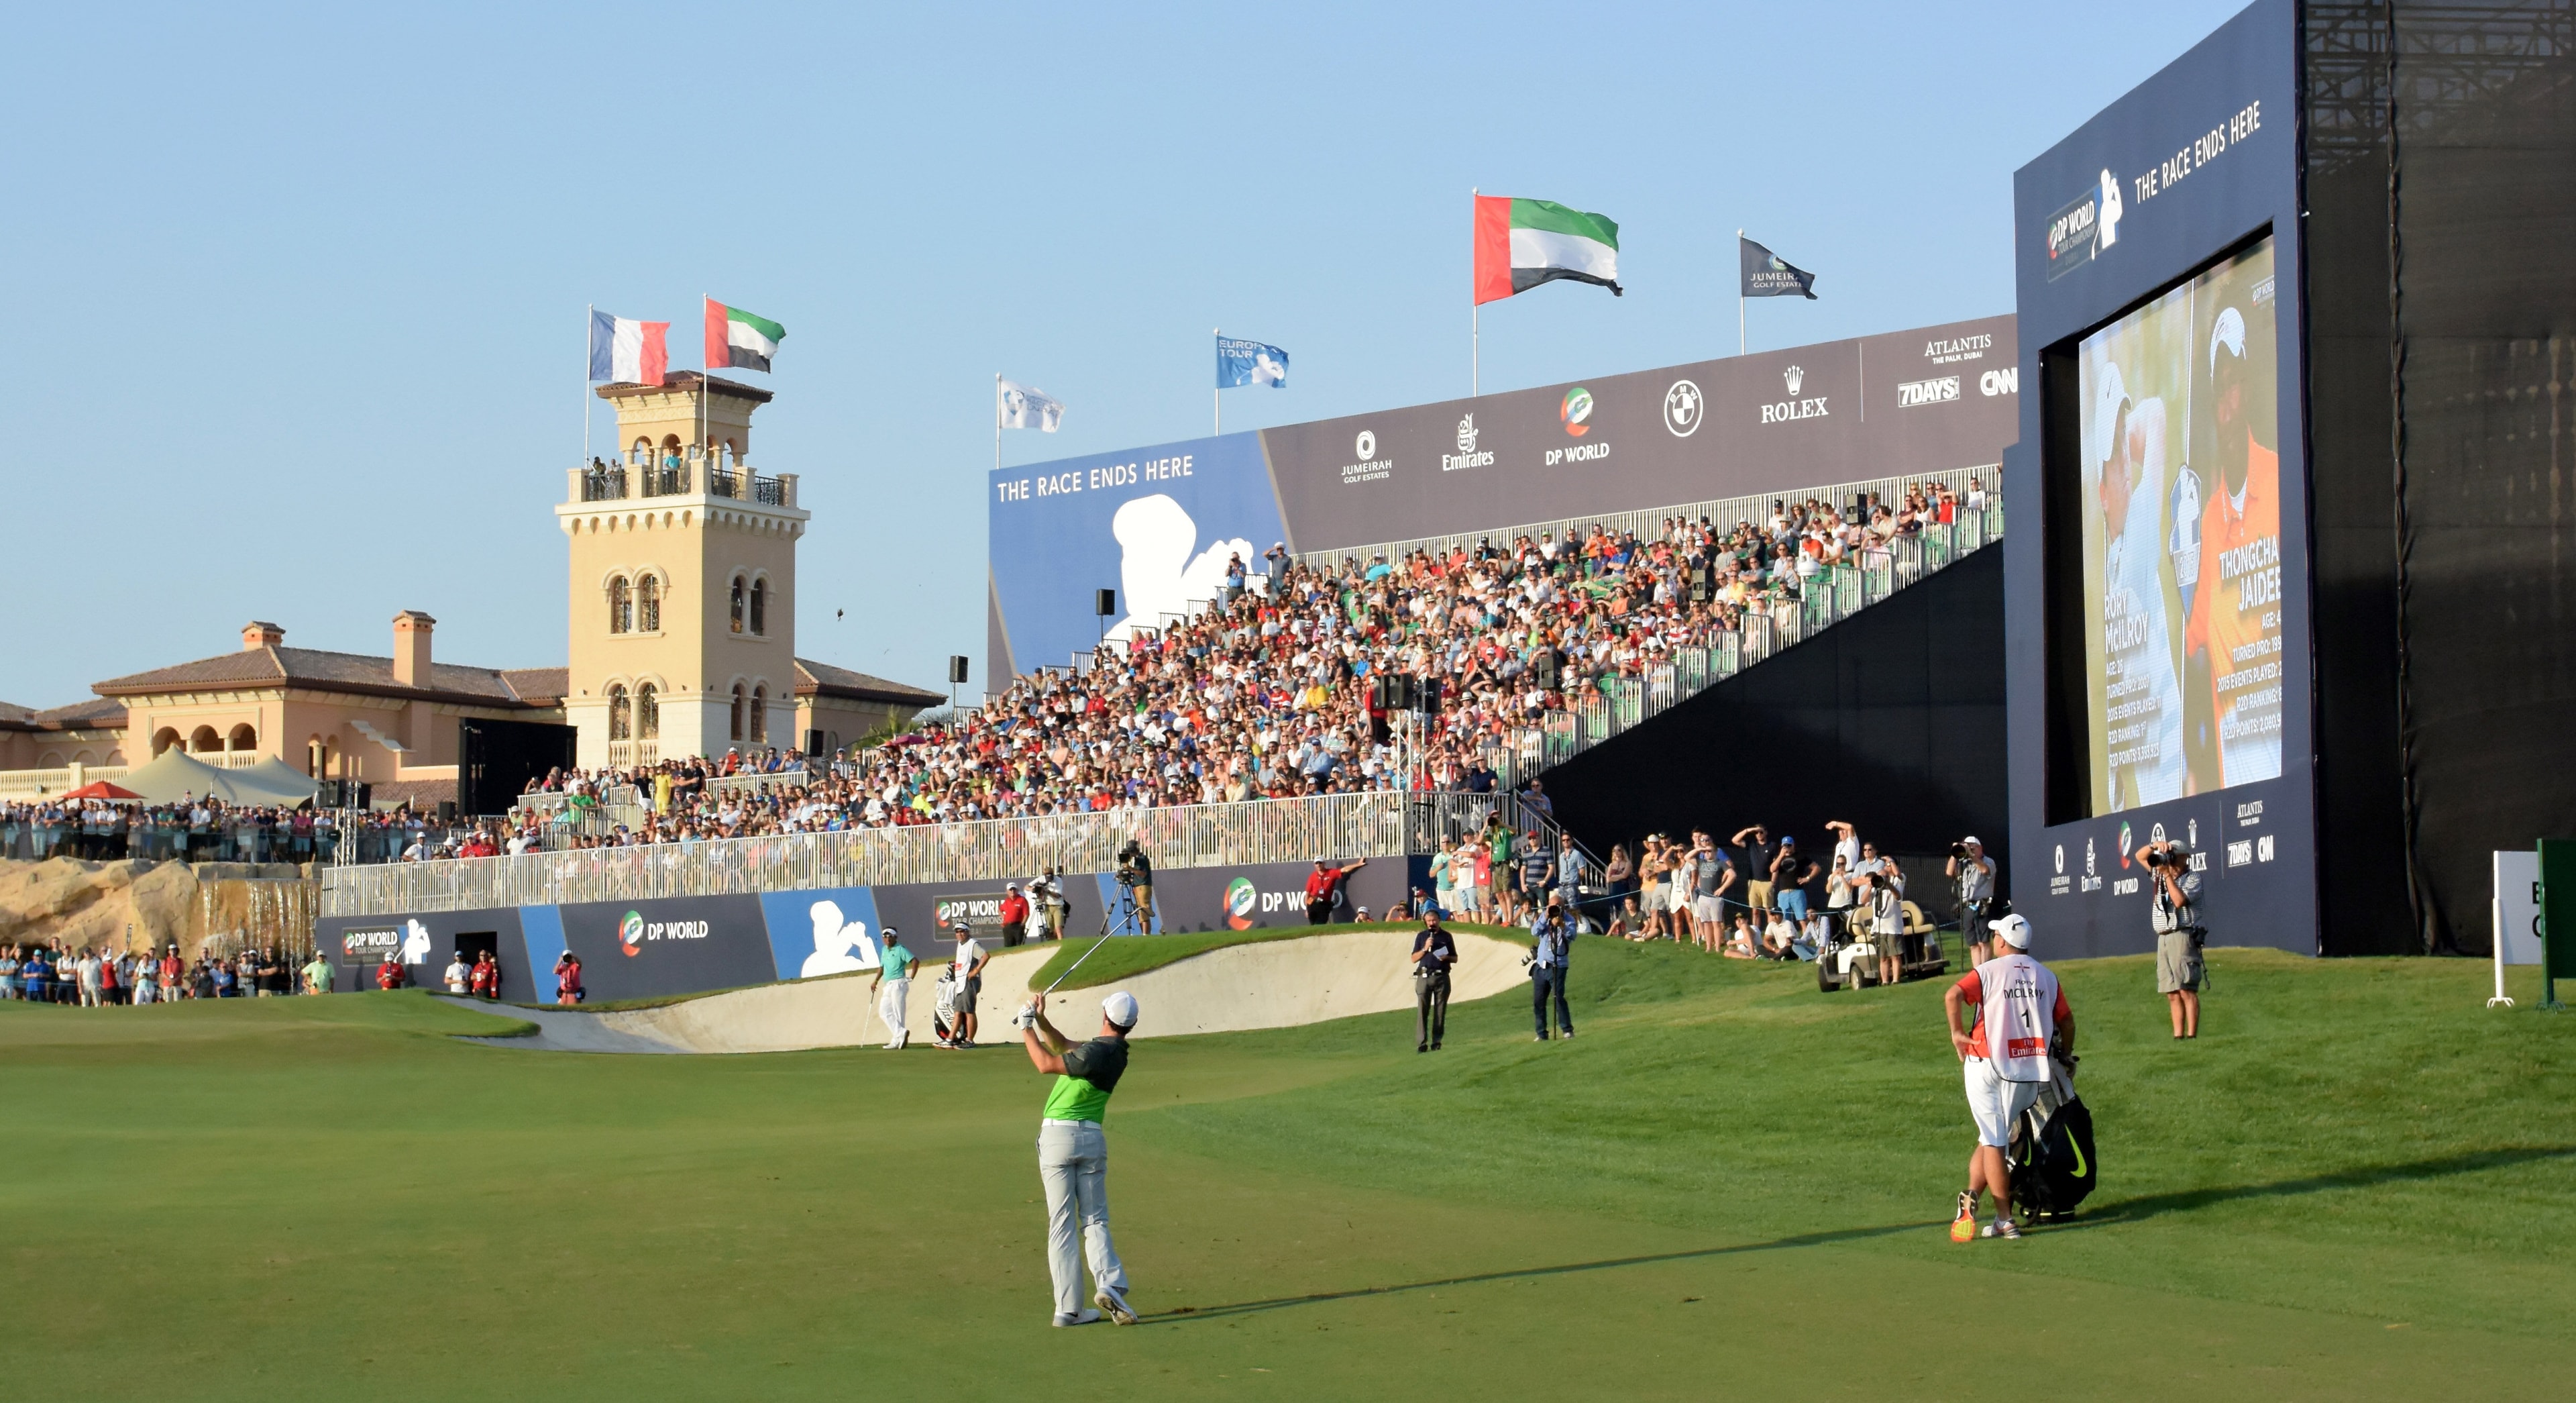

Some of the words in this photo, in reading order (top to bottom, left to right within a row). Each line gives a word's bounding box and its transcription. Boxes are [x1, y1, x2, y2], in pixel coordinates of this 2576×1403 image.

[2135, 168, 2157, 204] THE
[2162, 147, 2191, 189] RACE
[2195, 123, 2225, 168] ENDS
[2231, 100, 2261, 145] HERE
[2057, 217, 2068, 242] DP
[2068, 200, 2094, 235] WORLD
[1220, 348, 1253, 358] TOUR
[1924, 333, 1992, 357] ATLANTIS
[1933, 356, 1944, 364] THE
[1964, 351, 1982, 360] DUBAI
[1899, 378, 1955, 405] 7DAYS
[1980, 367, 2018, 397] CNN
[1761, 397, 1829, 423] ROLEX
[1442, 451, 1494, 471] Emirates
[1546, 449, 1562, 466] DP
[1564, 443, 1610, 462] WORLD
[1341, 459, 1392, 476] JUMEIRAH
[1344, 475, 1362, 483] GOLF
[1362, 471, 1389, 481] ESTATES
[998, 479, 1030, 503] THE
[1038, 471, 1082, 497] RACE
[1090, 463, 1137, 489] ENDS
[1146, 455, 1193, 481] HERE
[2219, 534, 2279, 580] THONGCHA
[2239, 565, 2281, 611] JAIDEE
[2104, 590, 2127, 621] RORY
[2261, 611, 2275, 630] AGE:
[2105, 611, 2148, 654] McILROY
[2233, 643, 2255, 663] TURNED
[2256, 639, 2271, 656] PRO:
[2106, 661, 2117, 677] AGE:
[2217, 675, 2231, 692] 2015
[2231, 668, 2253, 689] EVENTS
[2253, 662, 2277, 683] PLAYED:
[2106, 682, 2125, 699] TURNED
[2237, 696, 2248, 712] R2D
[2249, 688, 2277, 709] RANKING:
[2107, 706, 2118, 722] 2015
[2118, 701, 2137, 719] EVENTS
[2236, 718, 2259, 737] POINTS:
[2237, 800, 2263, 818] ATLANTIS
[2228, 842, 2251, 866] 7DAYS
[2114, 881, 2121, 896] DP
[2121, 878, 2139, 894] WORLD
[951, 901, 967, 917] DP
[1262, 892, 1283, 912] DP
[354, 933, 366, 947] DP
[367, 931, 398, 946] WORLD
[648, 923, 664, 940] DP
[665, 921, 708, 939] WORLD
[2021, 1008, 2030, 1028] 1
